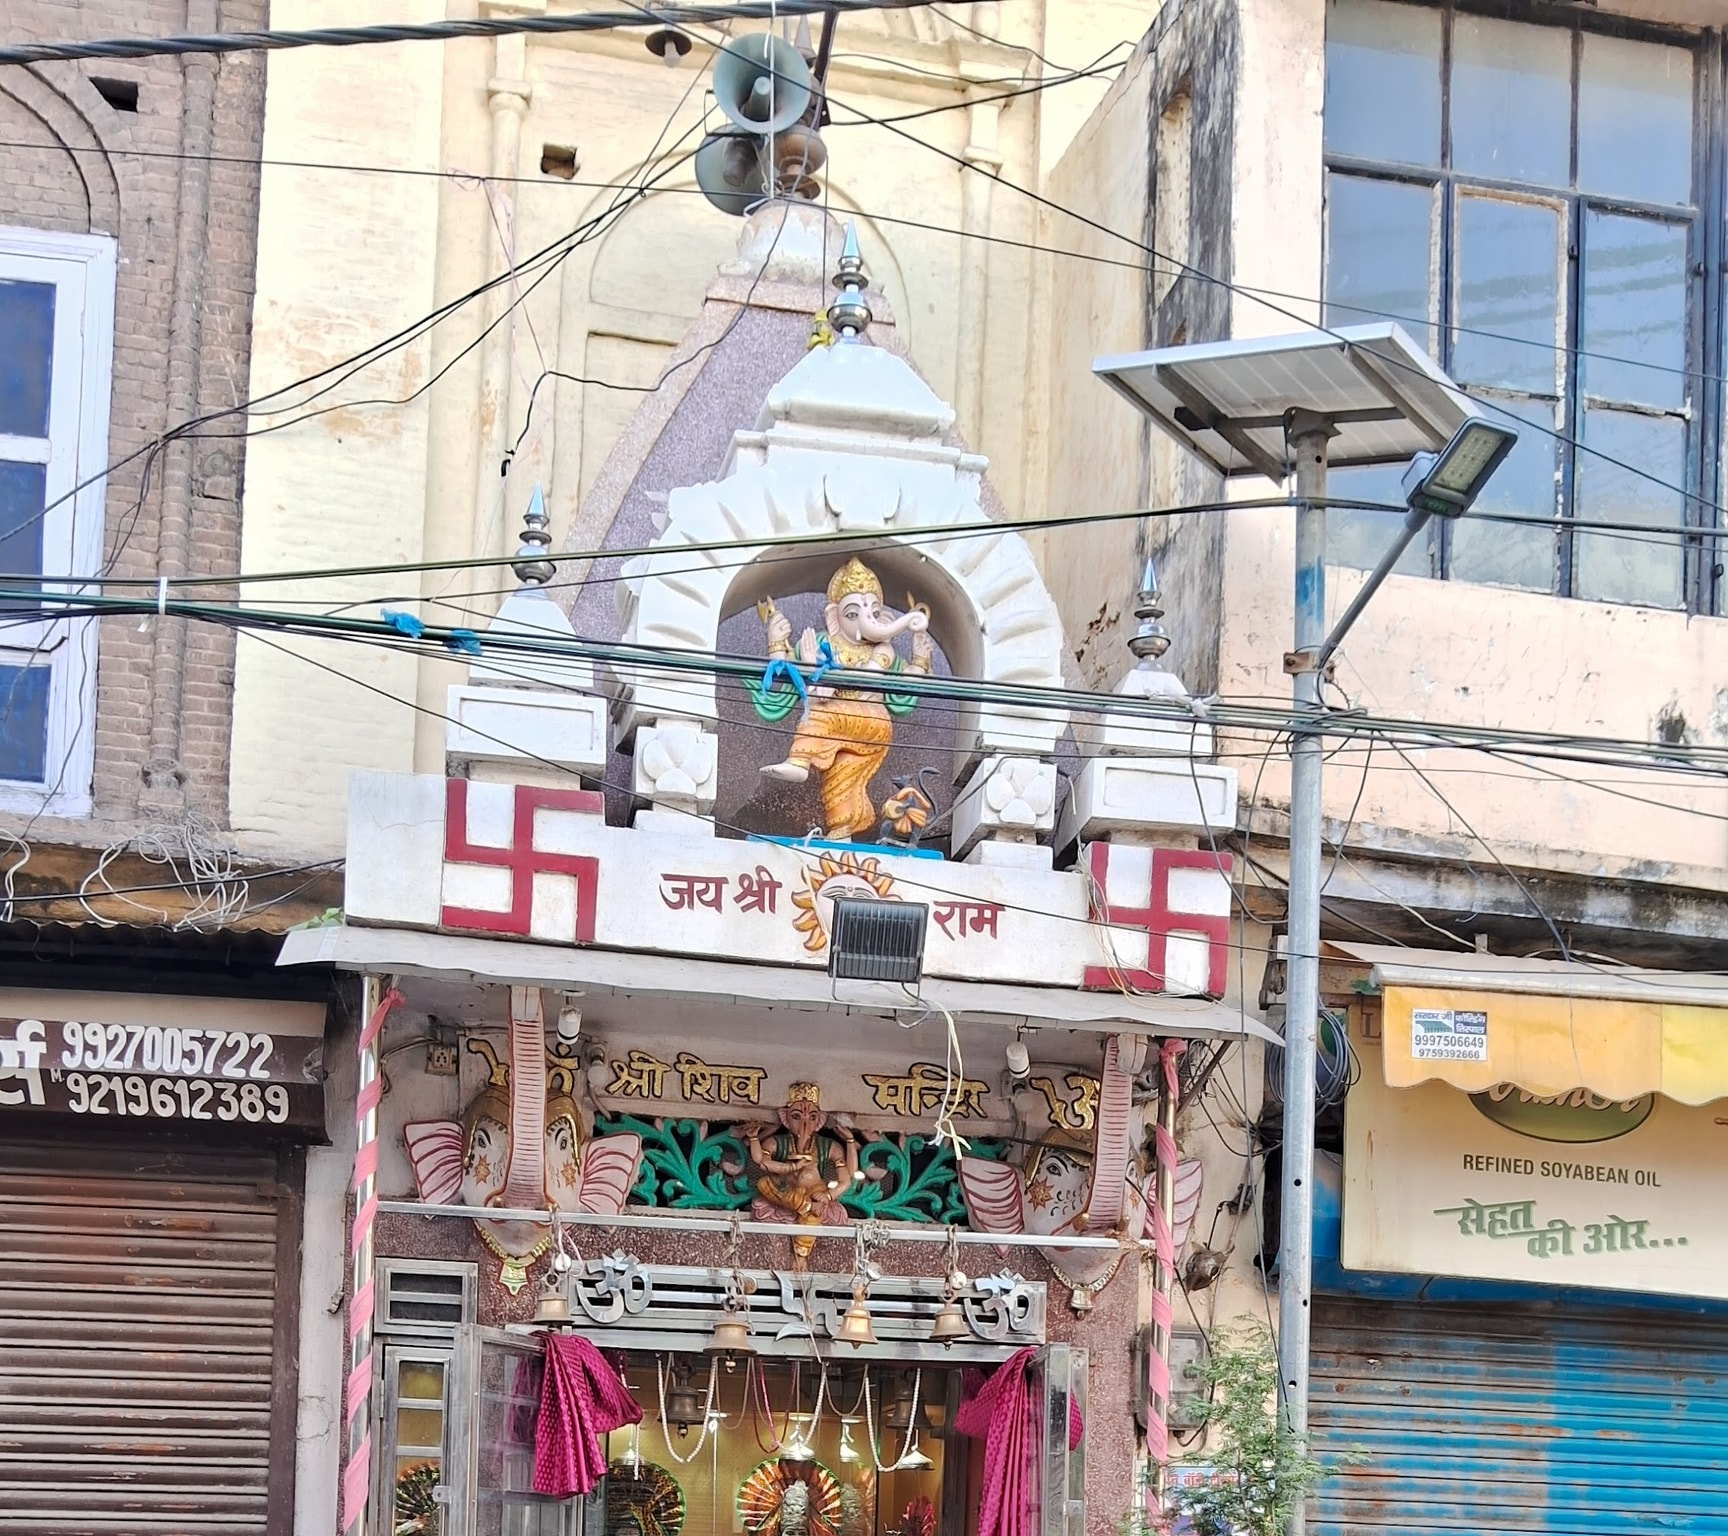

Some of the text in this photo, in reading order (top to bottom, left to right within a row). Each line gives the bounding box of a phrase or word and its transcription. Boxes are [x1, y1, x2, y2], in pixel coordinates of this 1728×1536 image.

[659, 864, 1005, 940] जय श्री राम
[61, 1020, 274, 1078] 9927005722
[1414, 1034, 1484, 1049] 9997506649
[1418, 1048, 1480, 1059] 9759392666
[66, 1072, 290, 1124] 9219612389
[606, 1049, 671, 1098] श्री
[674, 1051, 768, 1104] शिव
[1463, 1153, 1661, 1187] REFINED SOYABEAN OIL
[1433, 1197, 1537, 1239] सेहत
[1508, 1218, 1576, 1258] की
